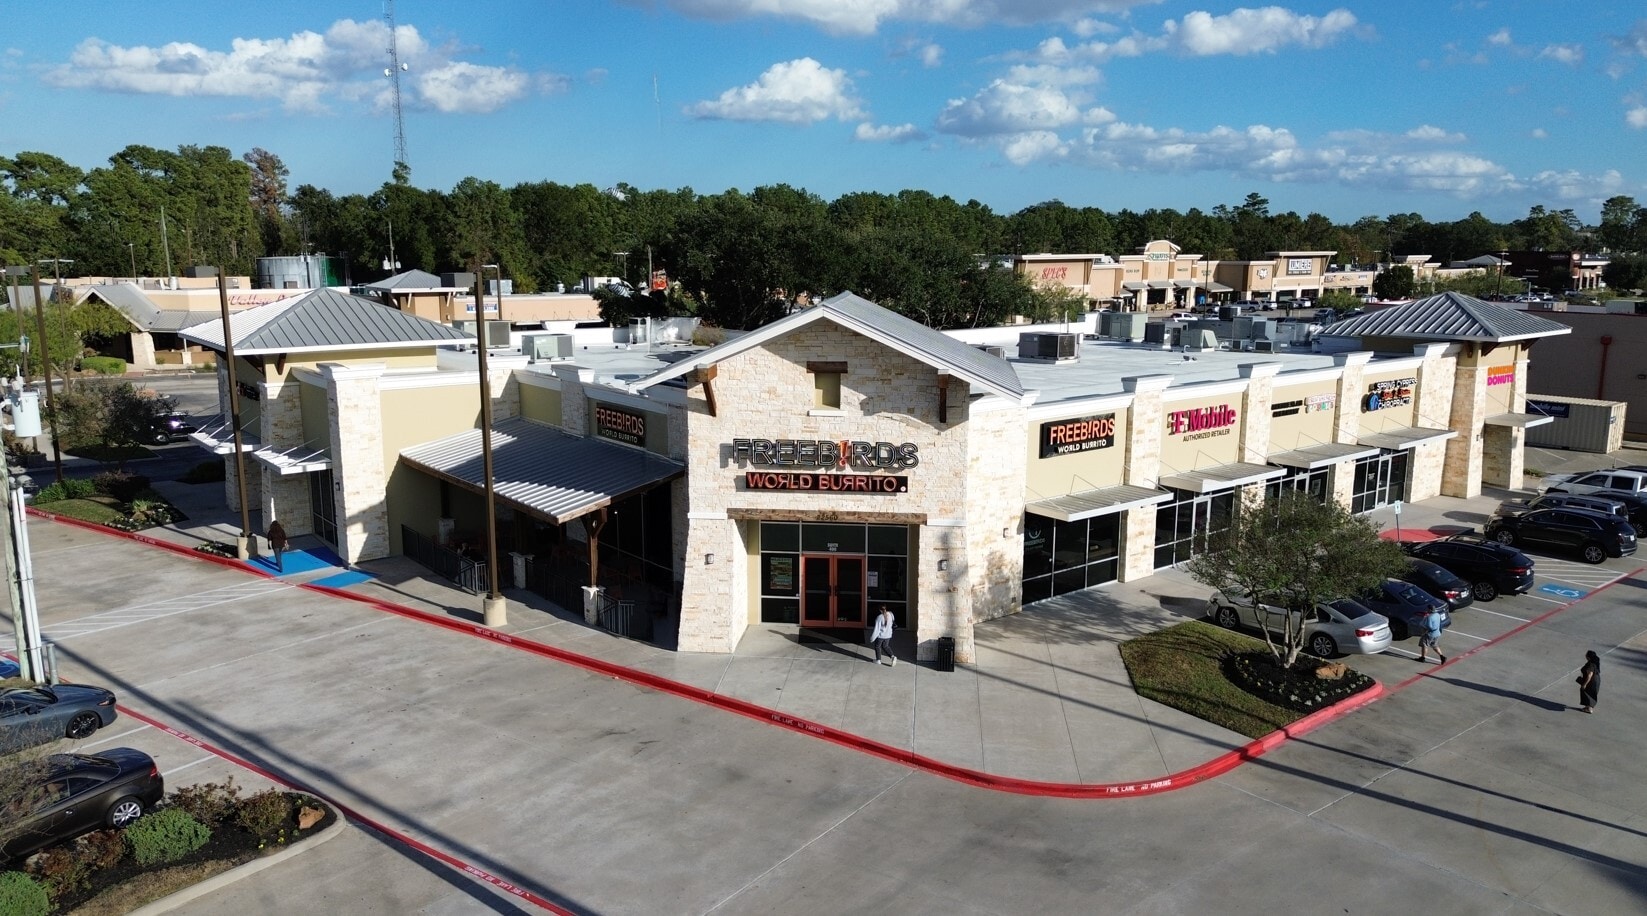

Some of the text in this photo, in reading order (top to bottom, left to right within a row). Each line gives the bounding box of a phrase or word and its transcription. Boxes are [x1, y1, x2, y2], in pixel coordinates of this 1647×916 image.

[1487, 374, 1514, 386] DONUTS
[596, 407, 644, 436] FREEB!RDS
[602, 429, 638, 443] WORLD BURRITO
[1050, 418, 1115, 445] FREEB!RDS
[1183, 429, 1231, 442] AUTHORIZED RETAILER
[732, 438, 919, 469] FREEB!RDS
[1058, 439, 1107, 454] WORLD BURRITO
[747, 472, 813, 490] WORLD
[1150, 779, 1172, 789] PARKING
